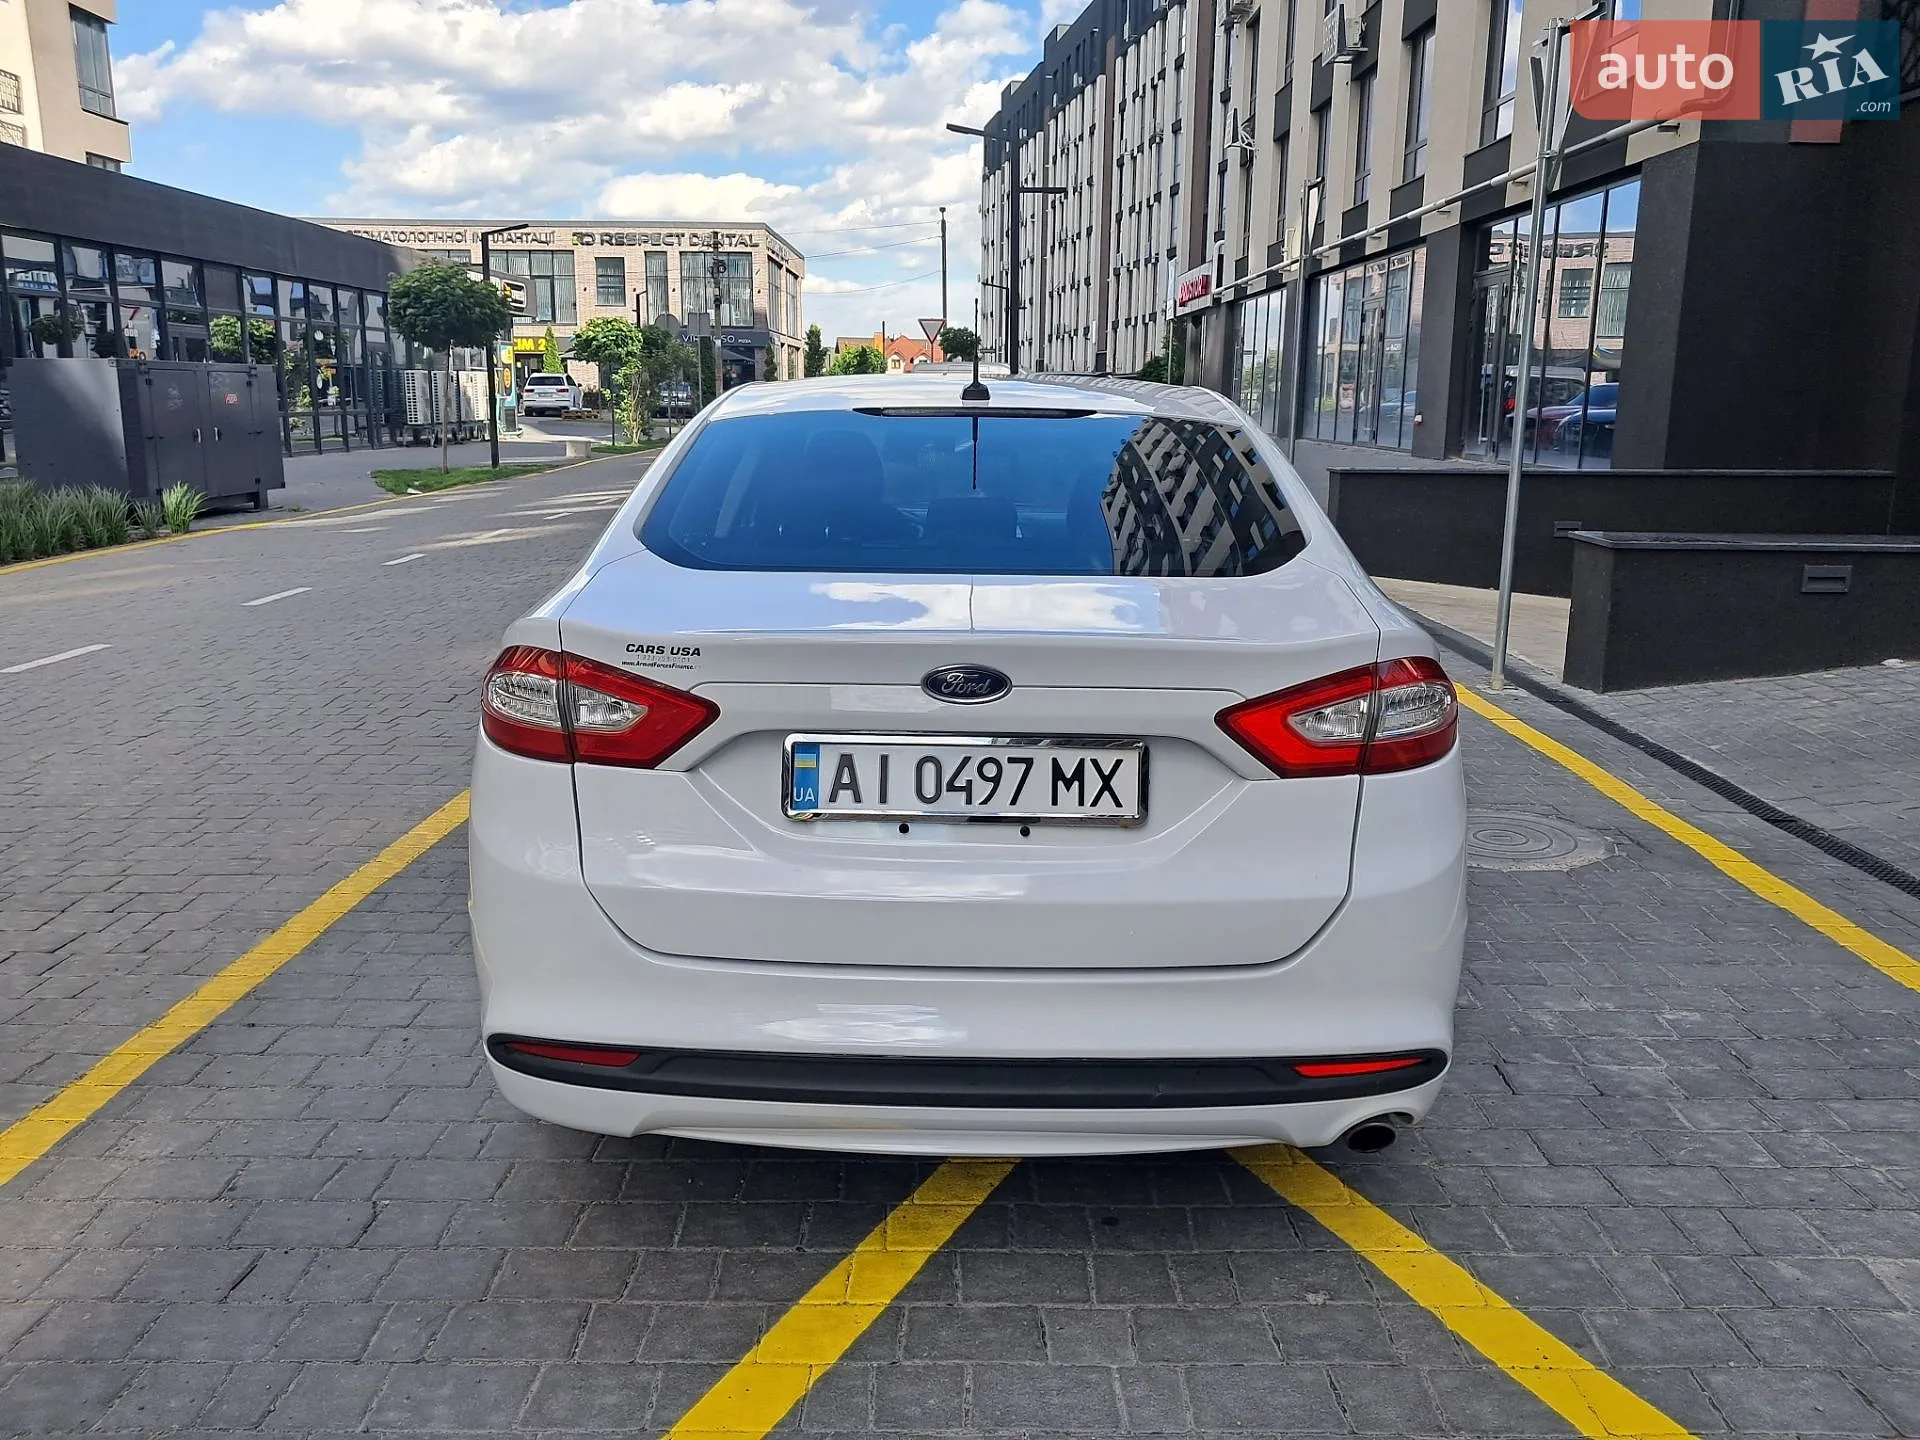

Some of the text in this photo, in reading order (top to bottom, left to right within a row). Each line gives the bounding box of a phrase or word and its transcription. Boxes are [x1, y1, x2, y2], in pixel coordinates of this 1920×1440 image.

[347, 230, 468, 245] МАТОЛОГІЧНОЇ
[600, 232, 685, 246] RESPECT
[626, 644, 701, 656] CARS USA
[941, 673, 991, 693] Ford
[828, 753, 1124, 808] AI 0497 MX
[794, 787, 815, 802] UA
